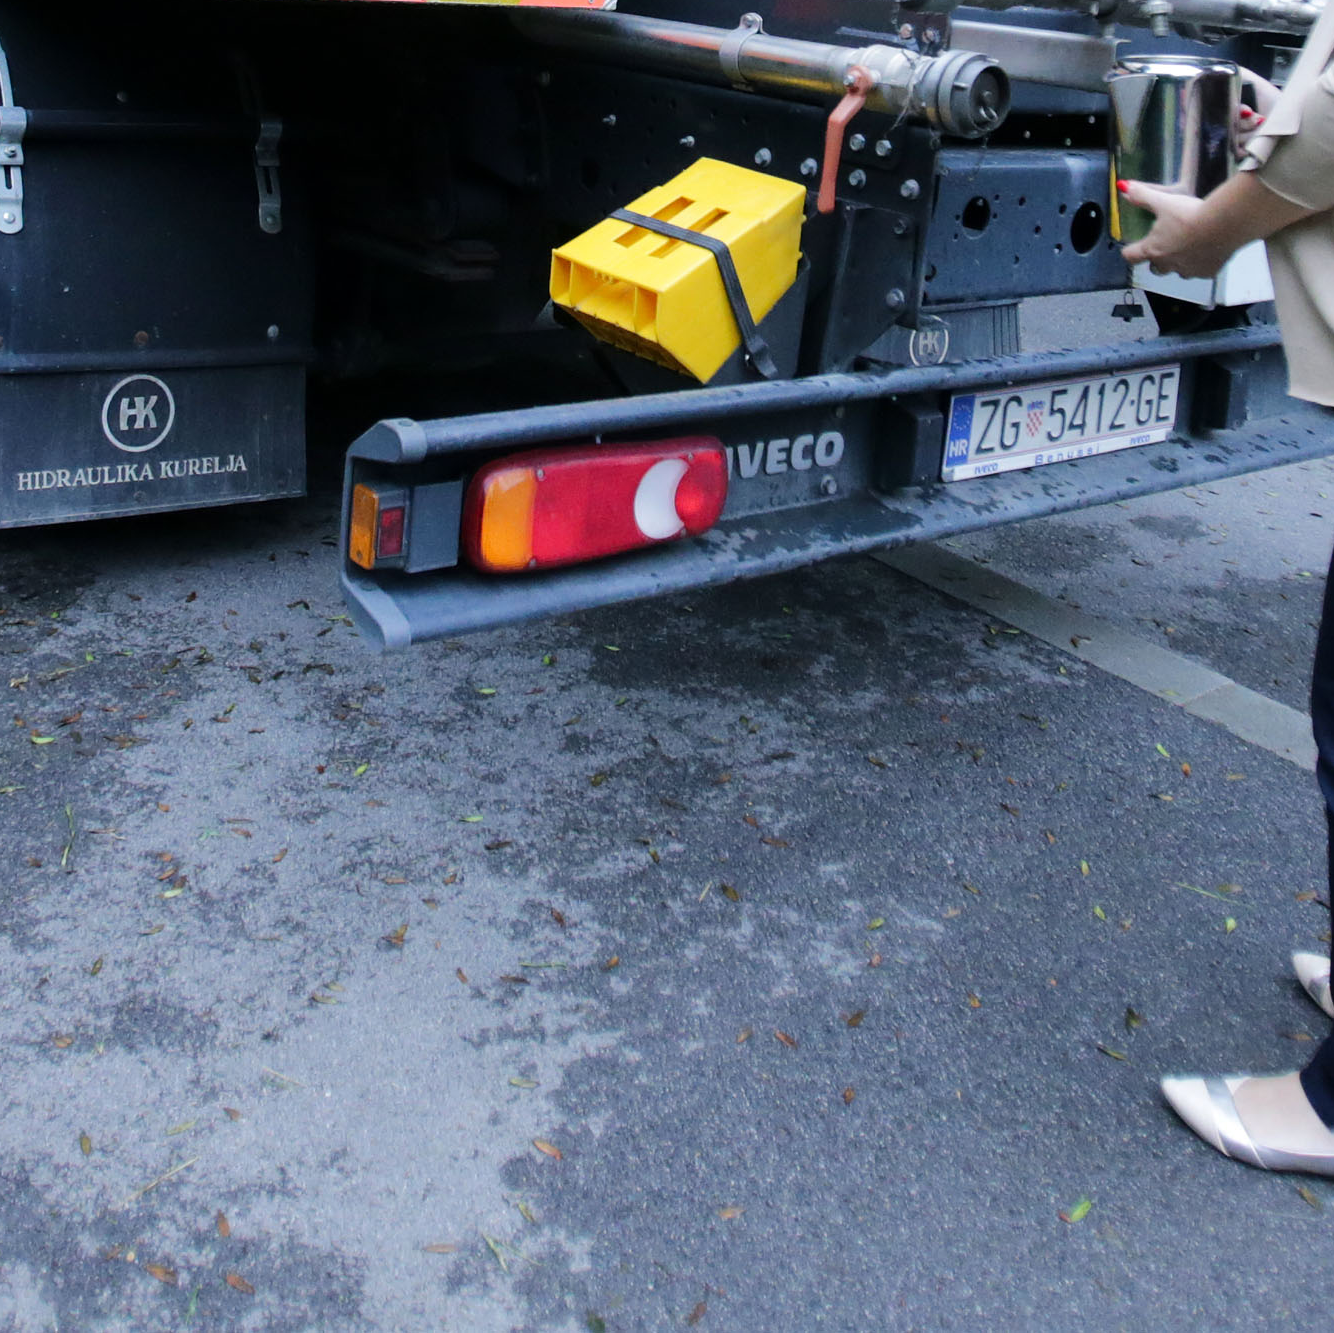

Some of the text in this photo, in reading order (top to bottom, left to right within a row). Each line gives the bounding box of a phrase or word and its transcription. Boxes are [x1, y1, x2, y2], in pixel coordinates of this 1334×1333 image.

[918, 331, 940, 356] HK
[119, 395, 159, 431] HK
[975, 395, 1023, 455] ZG
[949, 439, 968, 458] HR
[1035, 443, 1100, 466] Benussi
[17, 454, 247, 491] HIDRAULIKA KURELJA
